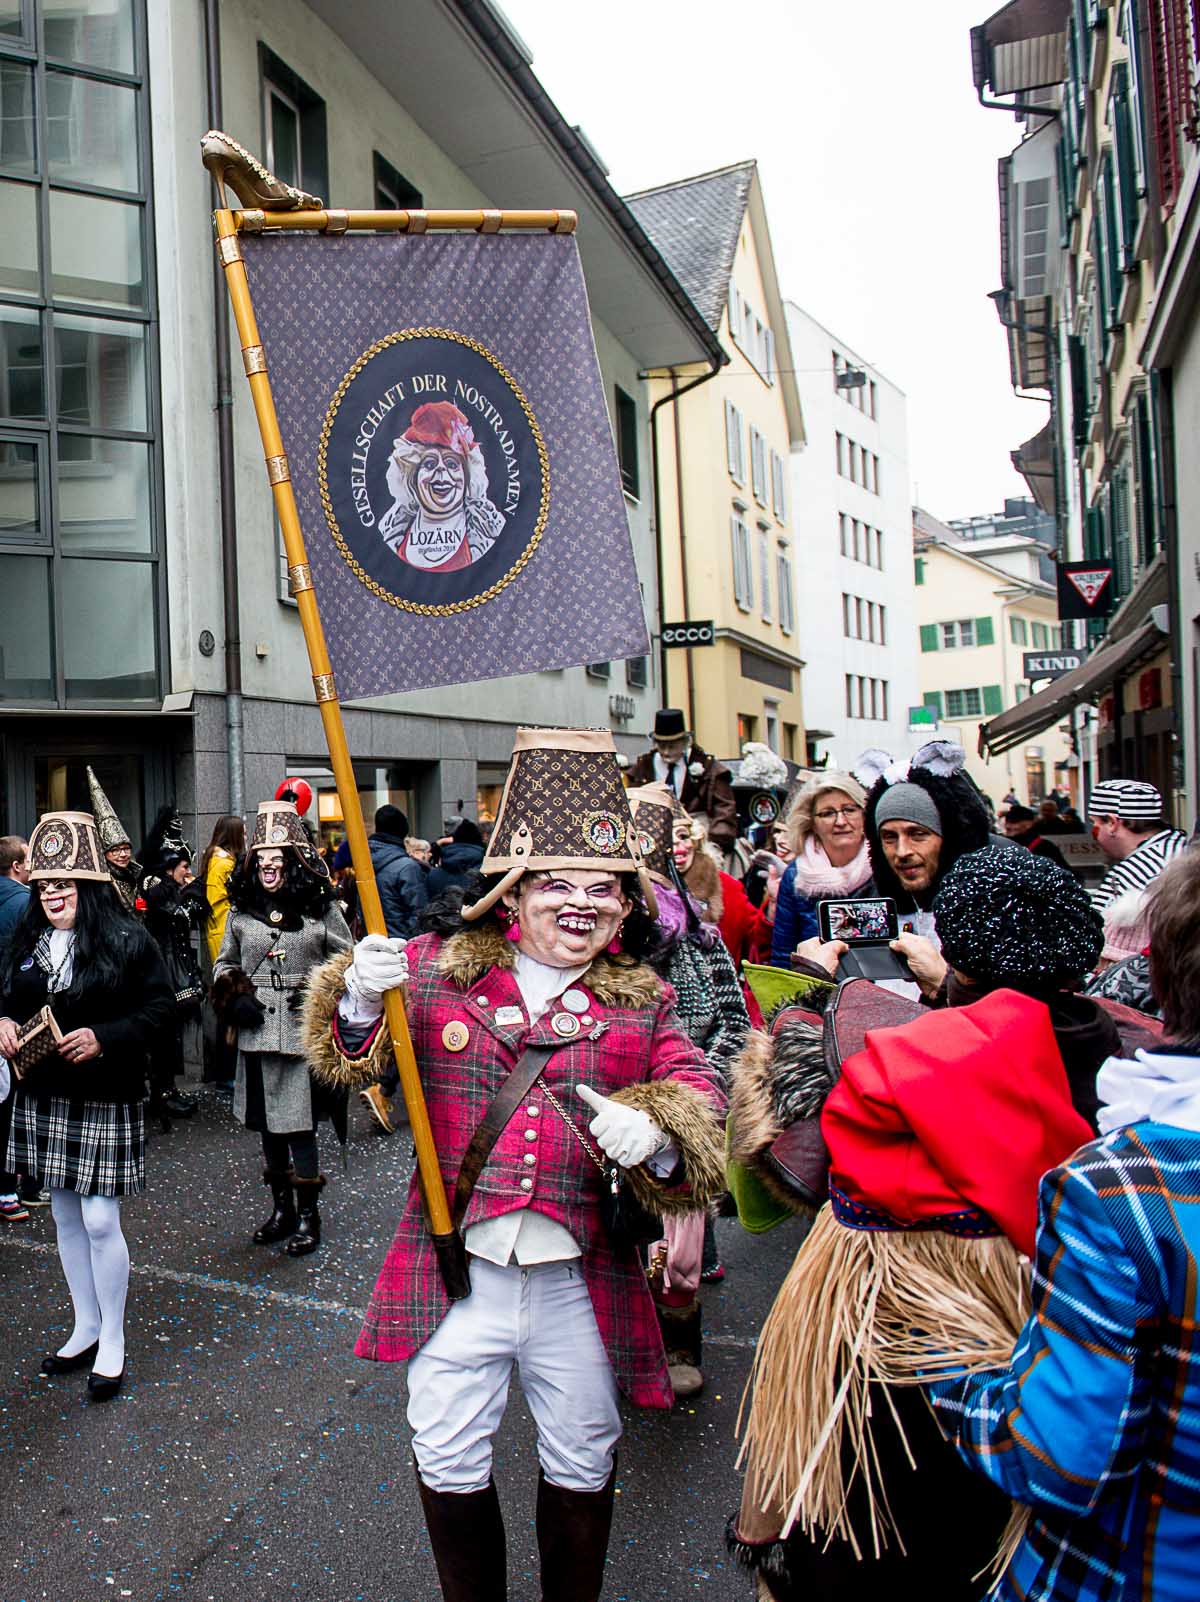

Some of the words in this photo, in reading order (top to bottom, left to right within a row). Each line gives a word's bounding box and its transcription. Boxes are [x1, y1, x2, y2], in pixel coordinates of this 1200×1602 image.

[351, 382, 406, 527] GESELLSCHAFT
[411, 374, 448, 393] DER
[455, 379, 521, 516] NOSTRADAMEN
[410, 528, 461, 545] LOZÄRN
[662, 627, 712, 643] ecco
[1027, 656, 1081, 672] KIND
